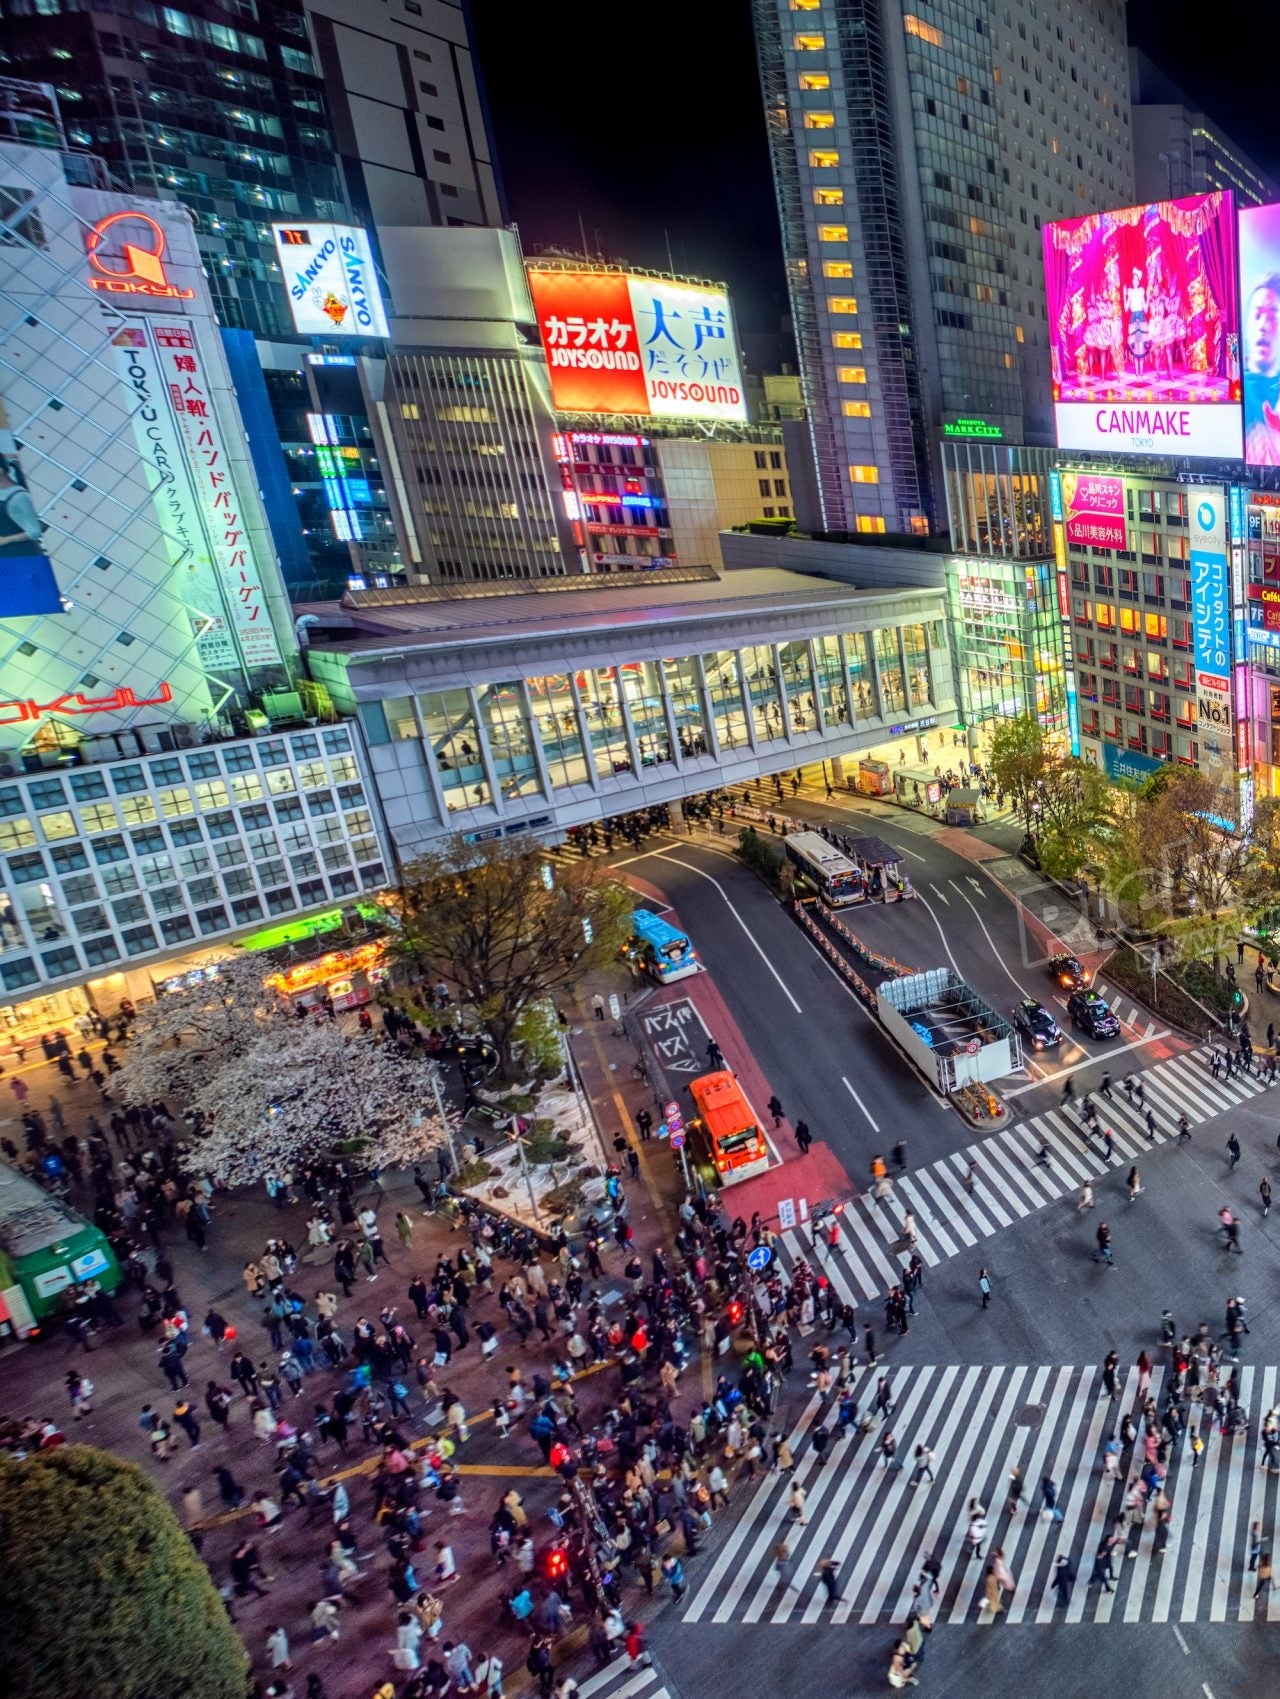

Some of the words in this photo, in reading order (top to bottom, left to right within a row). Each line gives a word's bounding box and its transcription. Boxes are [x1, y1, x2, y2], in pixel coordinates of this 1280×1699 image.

[291, 240, 336, 301] SANKYO
[340, 236, 372, 326] SANKYO
[89, 277, 195, 299] TOKYU
[545, 315, 632, 349] カラオケ
[639, 298, 727, 351] 大声
[551, 349, 640, 371] JOYSOUND
[651, 380, 740, 405] JOYSOUND
[123, 350, 158, 422] TOKYU
[146, 427, 175, 484] CARD
[1095, 409, 1191, 436] CANMAKE
[944, 424, 975, 434] MARK
[975, 426, 1001, 435] CITY
[1131, 437, 1154, 448] TOKYO
[1088, 482, 1121, 497] 品川スキン
[1088, 495, 1118, 509] クリニック
[1249, 515, 1261, 528] 9F
[1074, 524, 1123, 544] 品川美容外科
[1193, 534, 1221, 545] eyecity
[1193, 561, 1212, 665] アイシティ
[1211, 563, 1226, 667] コンタクトの
[1250, 607, 1264, 621] 7F
[1199, 699, 1231, 727] No.1
